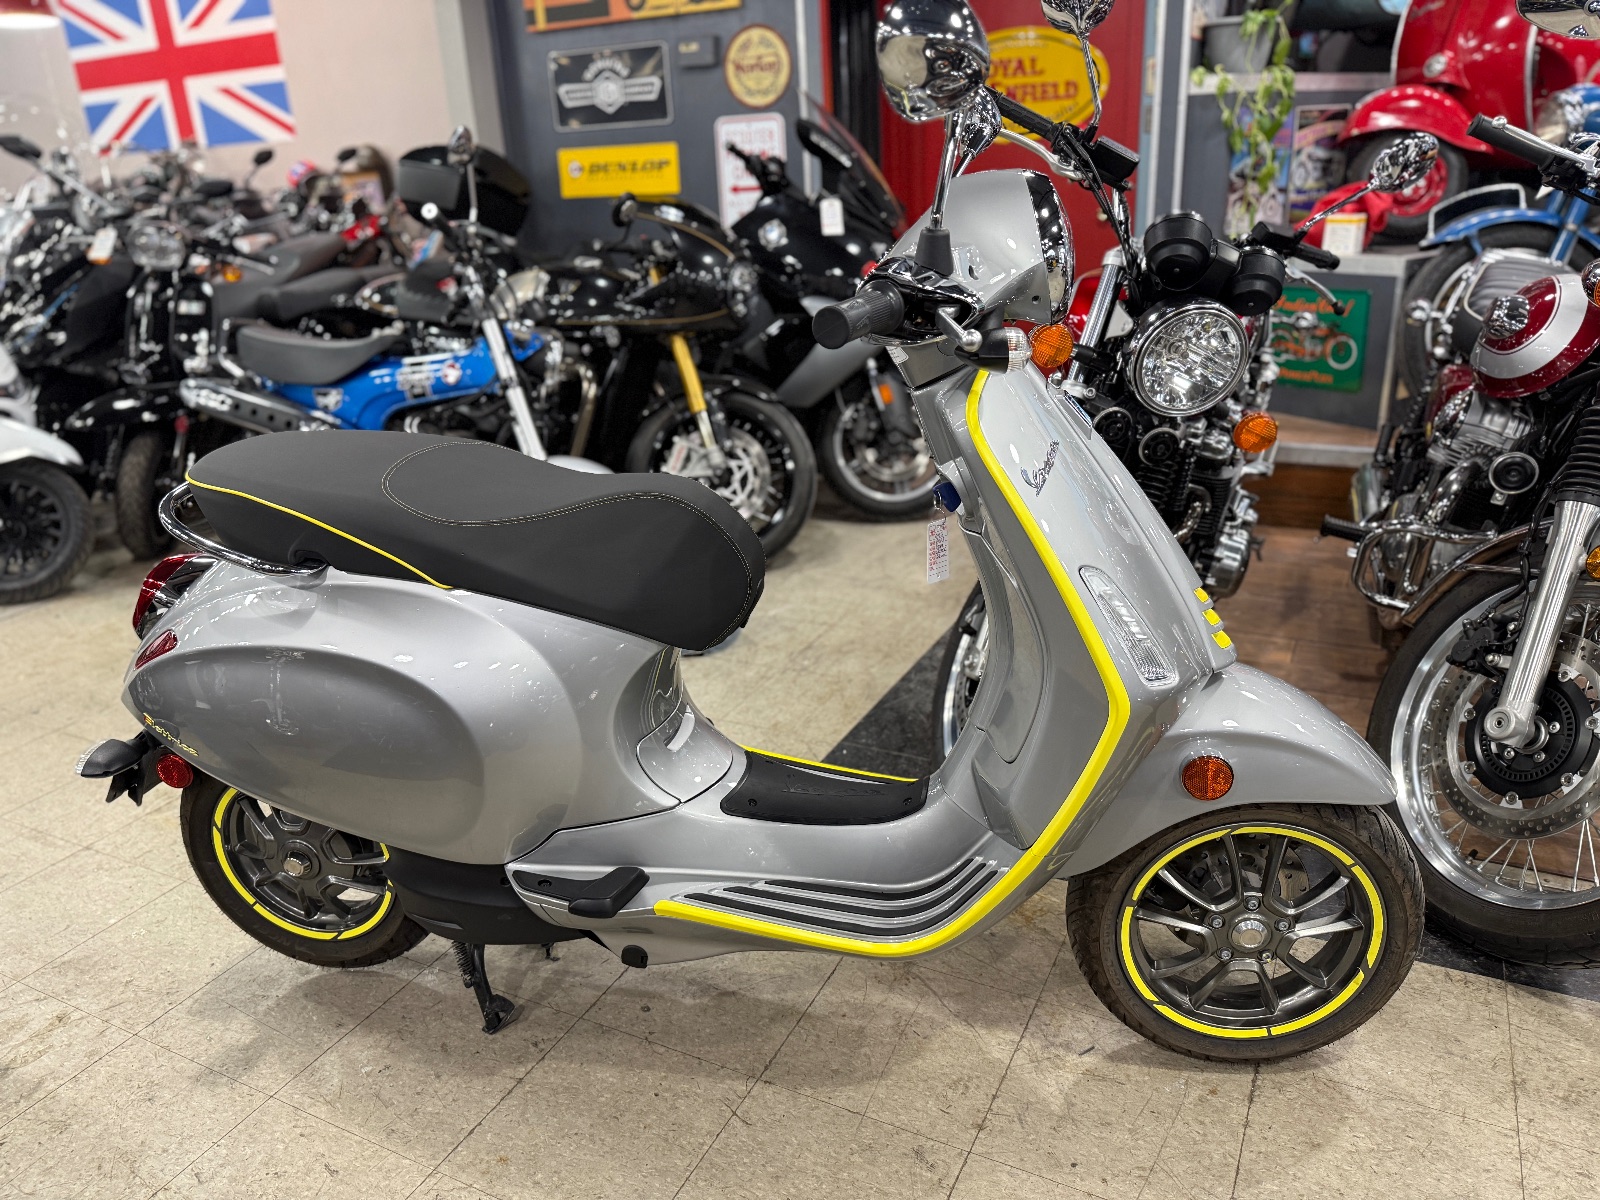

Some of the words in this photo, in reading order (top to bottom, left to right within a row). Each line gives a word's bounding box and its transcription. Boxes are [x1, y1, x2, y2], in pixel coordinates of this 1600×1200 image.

[988, 56, 1045, 78] OYAL
[989, 80, 1079, 103] NFIELD
[588, 158, 671, 173] DUNLOP
[1020, 440, 1060, 497] Vespa
